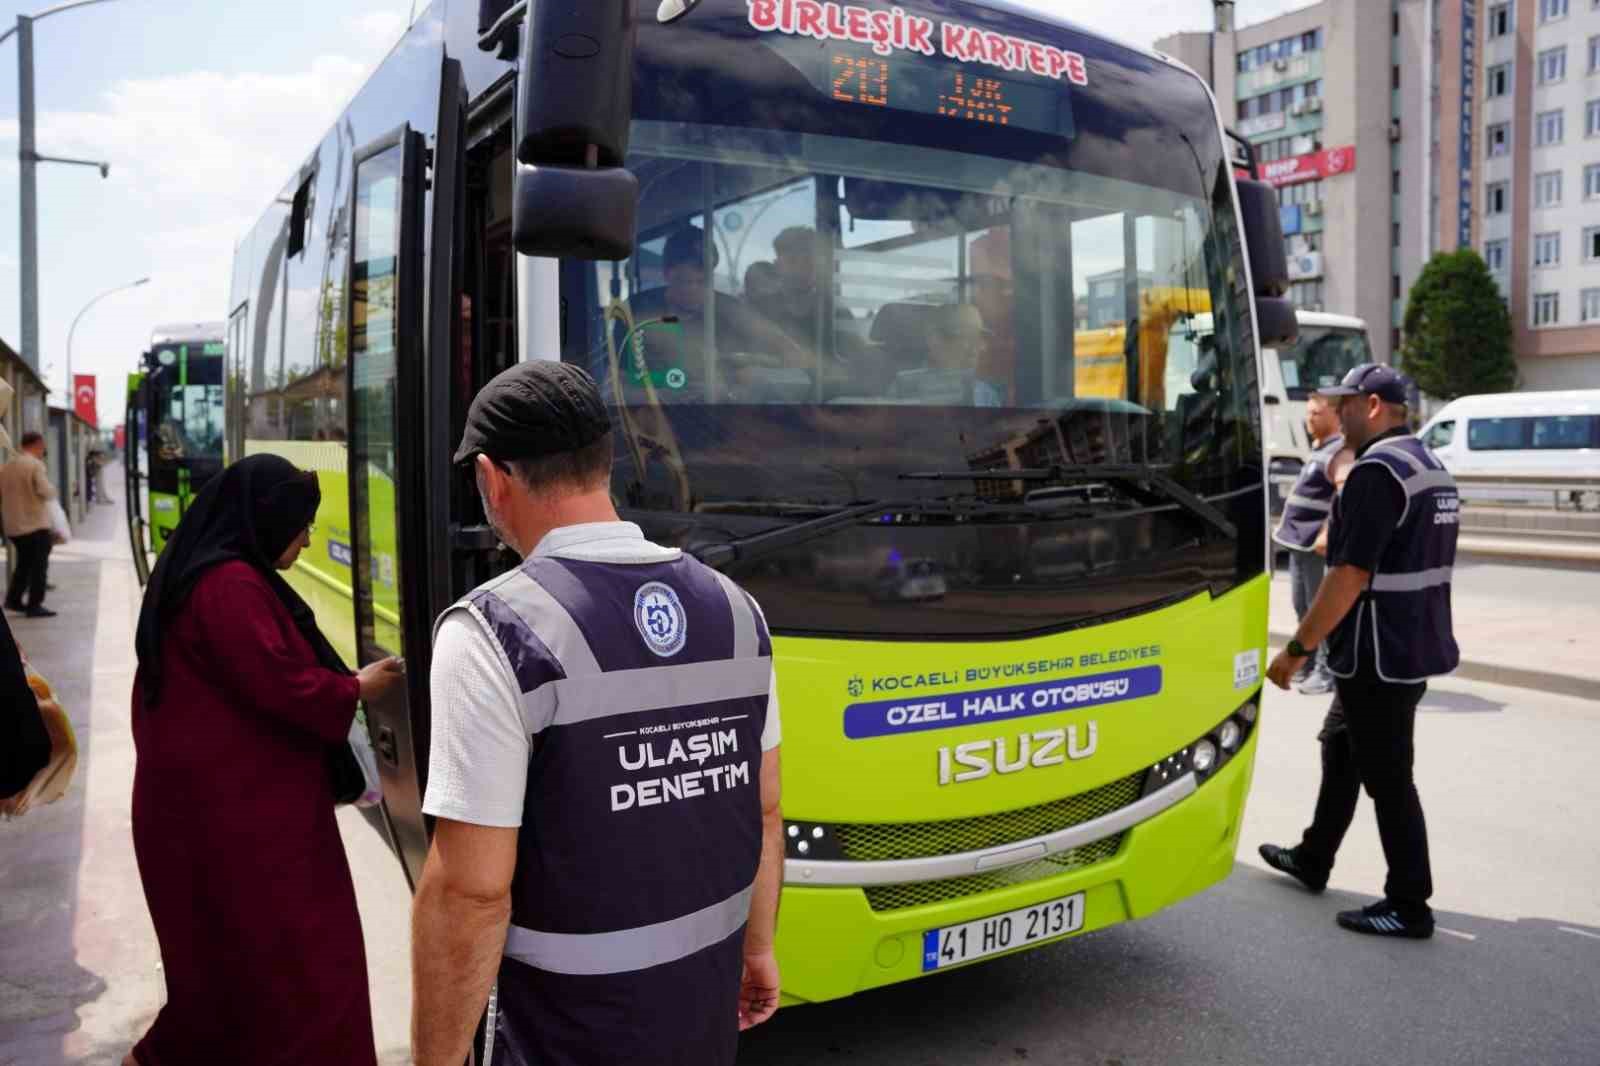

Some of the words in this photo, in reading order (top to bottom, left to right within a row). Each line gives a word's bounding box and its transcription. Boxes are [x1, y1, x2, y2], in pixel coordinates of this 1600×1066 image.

[941, 22, 1088, 85] KARTEPE
[963, 692, 1026, 717] HALK
[1031, 677, 1129, 708] OTOBÜSÜ
[618, 728, 739, 771] ULAŞIM
[939, 720, 1098, 786] ISUZU
[610, 760, 750, 812] DENETİM
[941, 926, 968, 961] 41
[1026, 899, 1075, 940] 2131
